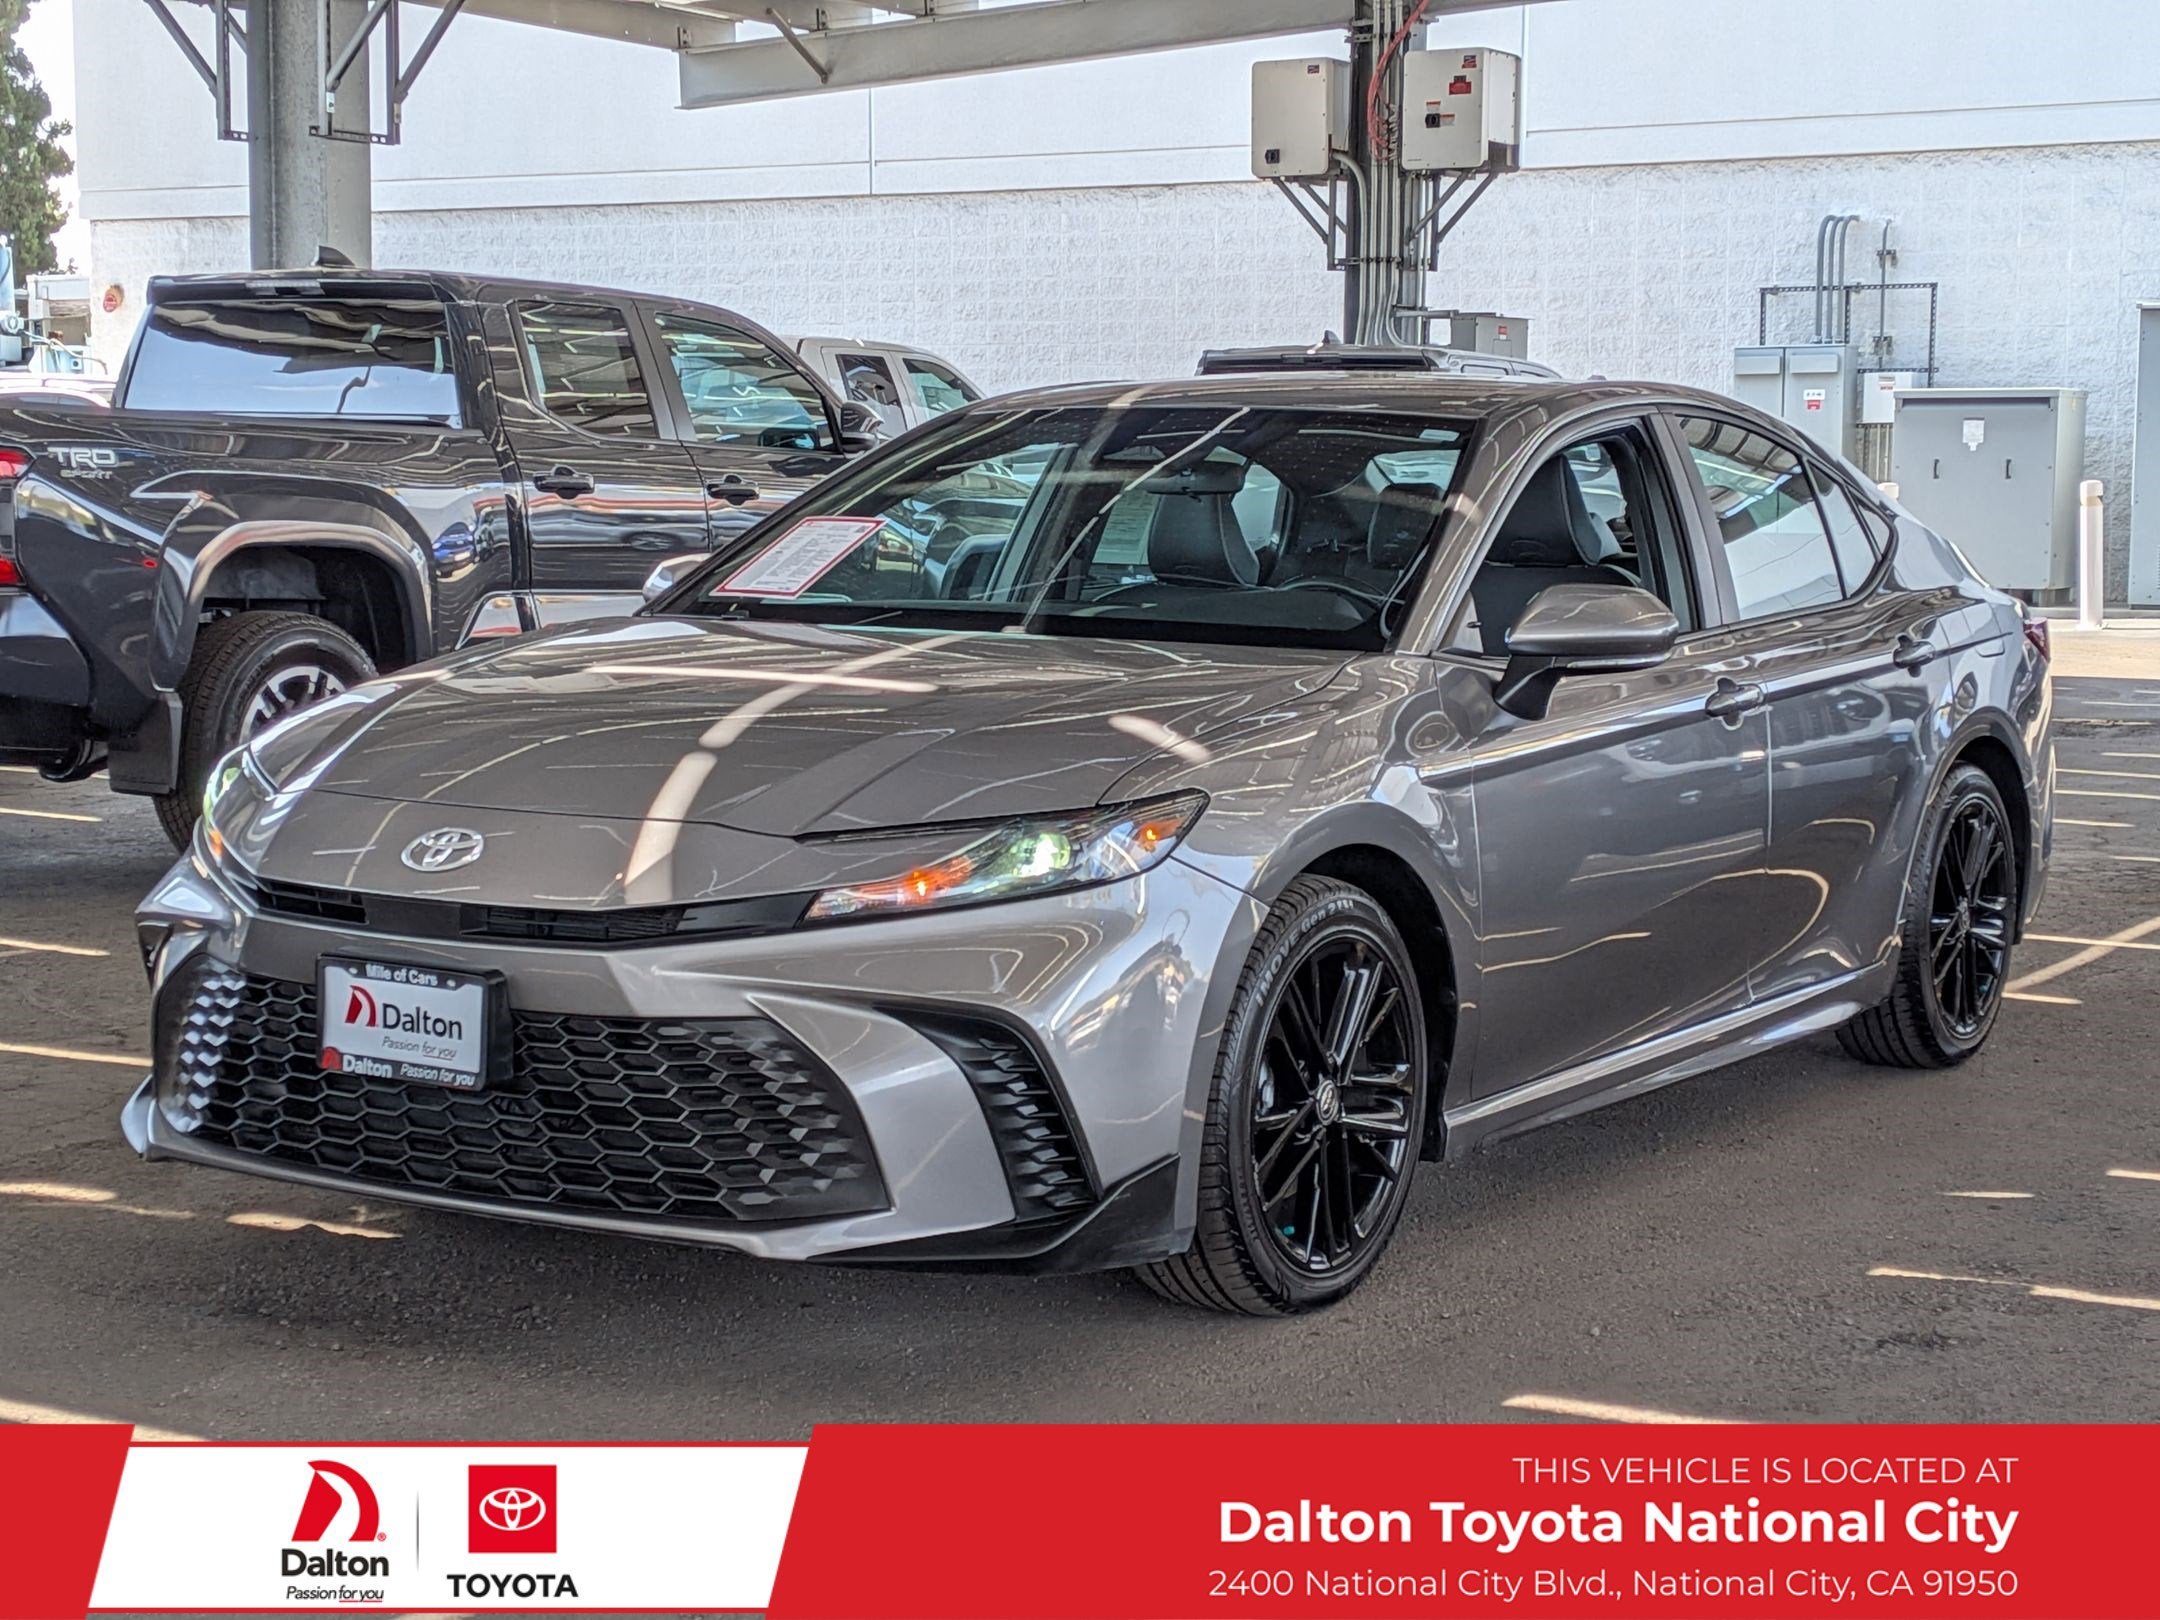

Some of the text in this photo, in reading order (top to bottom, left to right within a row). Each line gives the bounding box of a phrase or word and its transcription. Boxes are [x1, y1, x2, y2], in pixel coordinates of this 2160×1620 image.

[47, 447, 116, 469] TRD
[365, 963, 439, 987] Mile of Cars
[382, 1003, 462, 1040] Dalton
[382, 1035, 457, 1058] Passion for you
[342, 1055, 476, 1087] Dalton Passion for you
